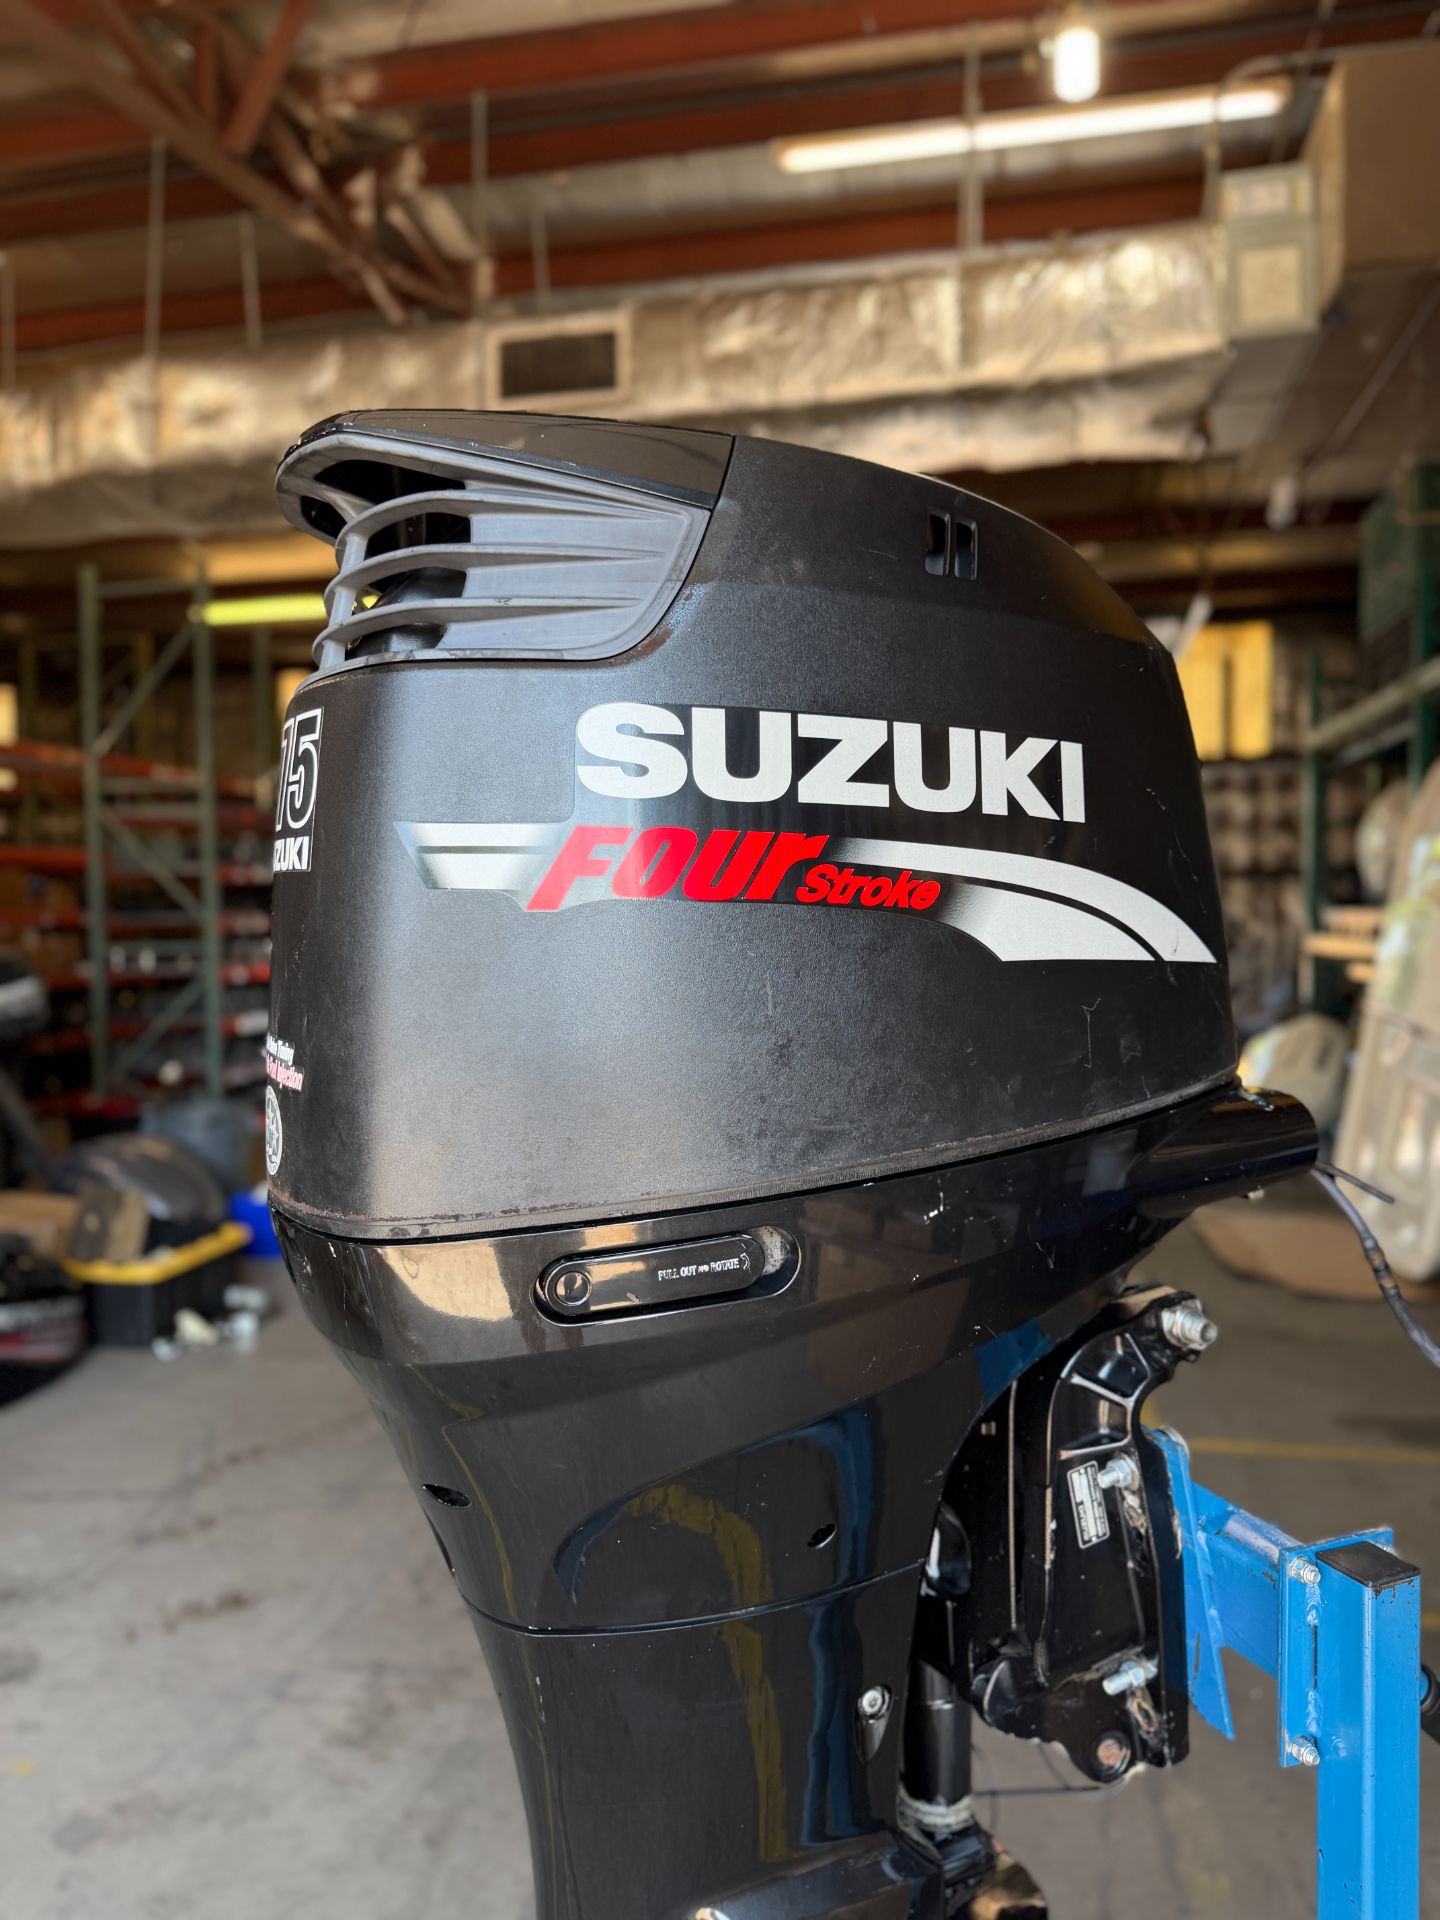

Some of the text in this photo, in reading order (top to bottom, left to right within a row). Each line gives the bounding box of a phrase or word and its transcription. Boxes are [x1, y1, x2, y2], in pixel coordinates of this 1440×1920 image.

[577, 702, 1085, 823] SUZUKI
[796, 863, 941, 910] Stroke
[657, 1268, 679, 1281] PULL
[680, 1265, 697, 1277] OUT
[710, 1258, 740, 1273] ROTATE
